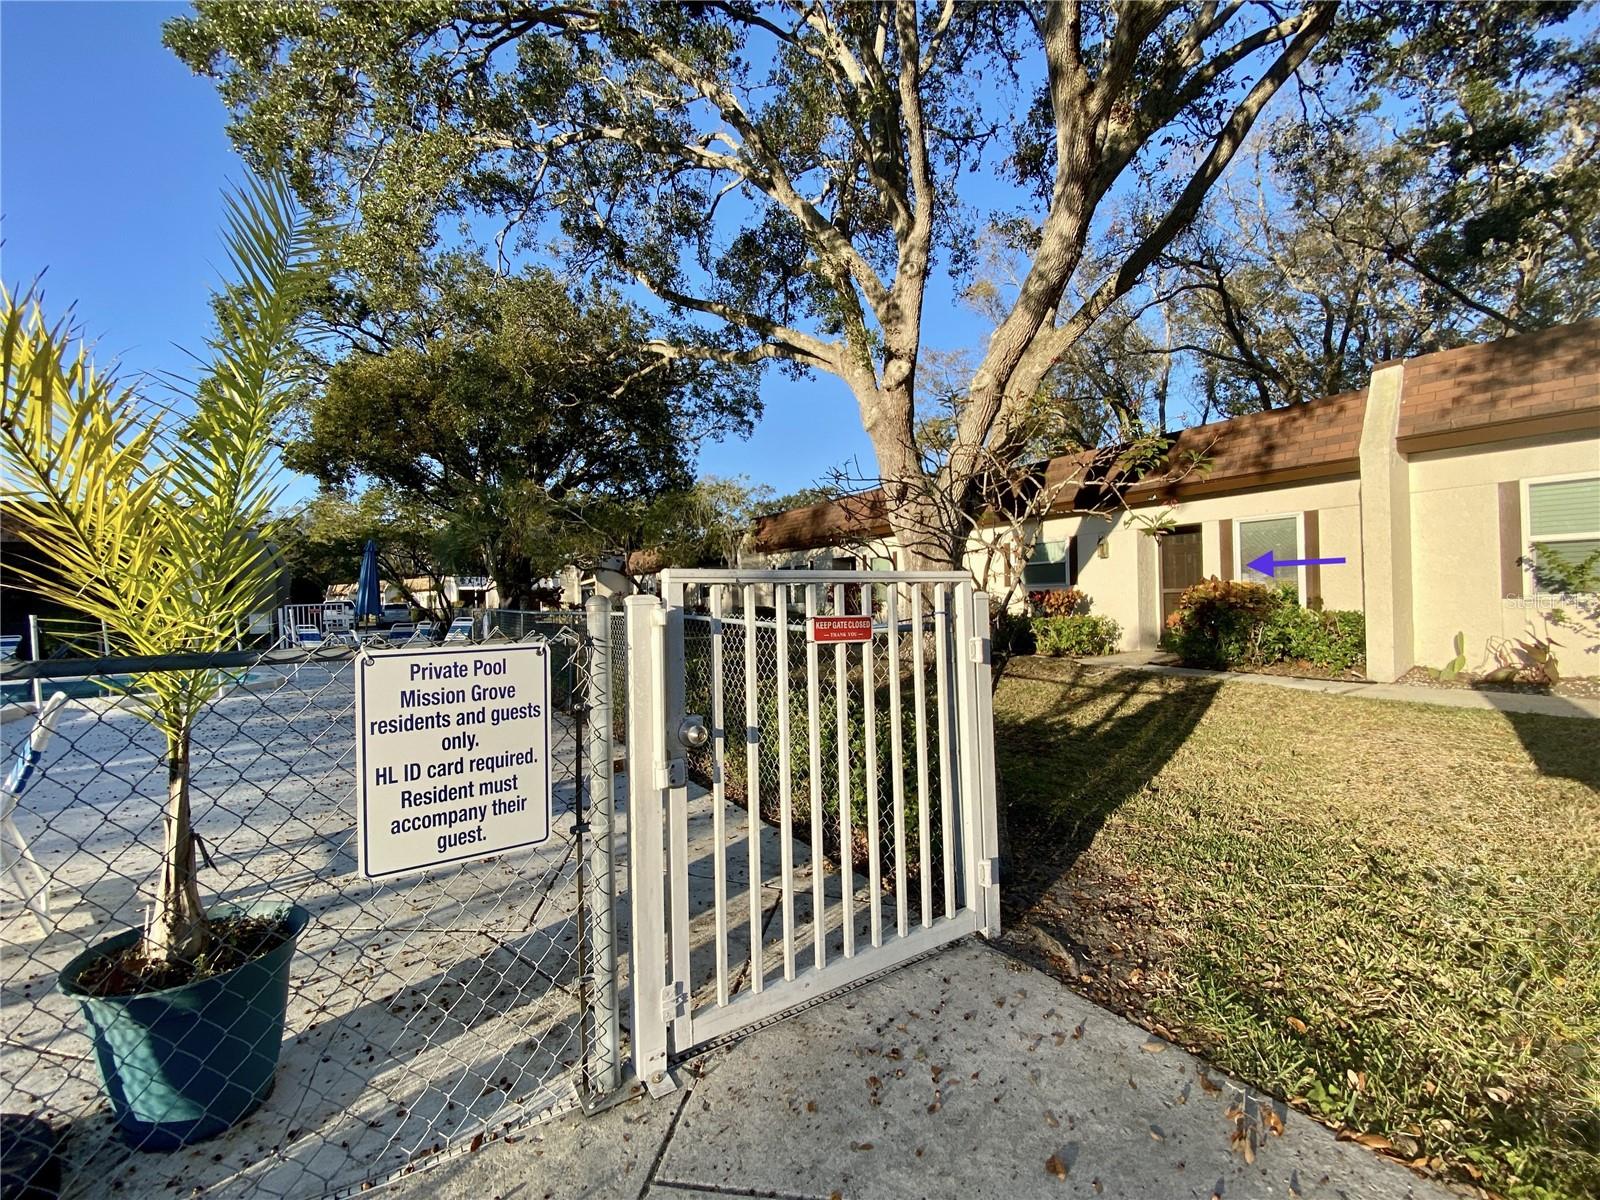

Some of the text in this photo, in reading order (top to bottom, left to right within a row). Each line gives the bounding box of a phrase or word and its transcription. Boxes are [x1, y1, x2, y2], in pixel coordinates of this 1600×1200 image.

[815, 620, 870, 629] KEEP GATE CLOSED
[410, 658, 507, 681] Private Pool
[400, 684, 516, 709] Mission Grove
[370, 702, 541, 735] residents and guests
[441, 731, 480, 752] only.
[375, 747, 538, 786] HL ID card required.
[401, 774, 519, 809] Resident must
[390, 795, 527, 835] accompany their
[437, 825, 487, 854] guest.
